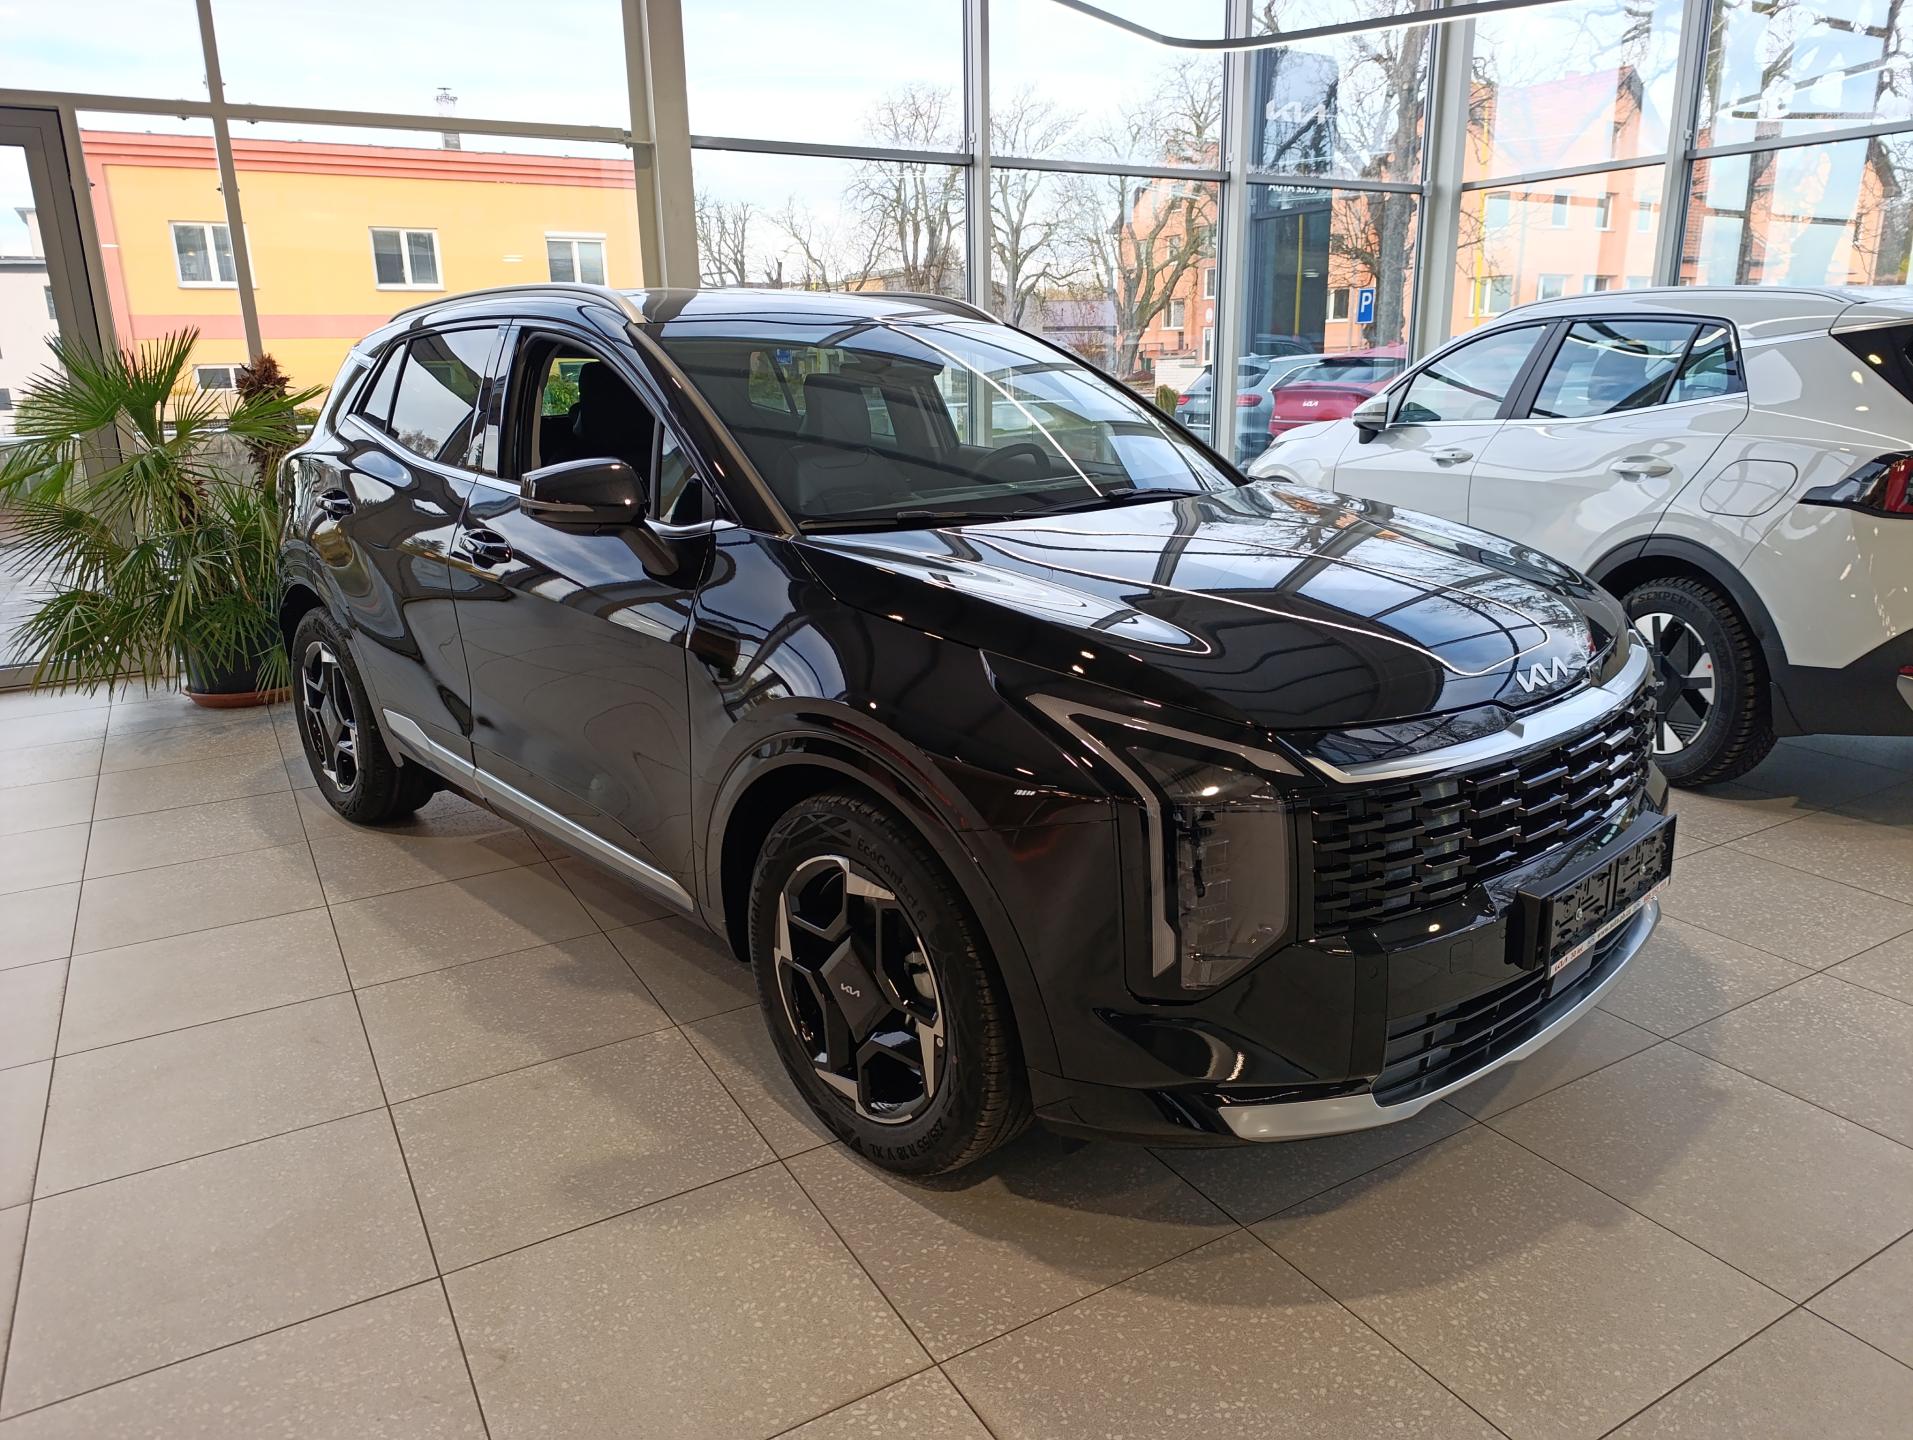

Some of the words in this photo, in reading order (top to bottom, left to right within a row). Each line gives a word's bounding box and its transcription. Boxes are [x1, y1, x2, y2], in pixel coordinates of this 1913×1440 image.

[1360, 292, 1372, 313] P
[1638, 591, 1698, 612] SEMPERIT
[1516, 656, 1569, 693] KIA
[857, 838, 919, 909] EcoContact
[917, 910, 928, 923] 6
[1553, 956, 1569, 972] KIA
[840, 982, 861, 998] KIA
